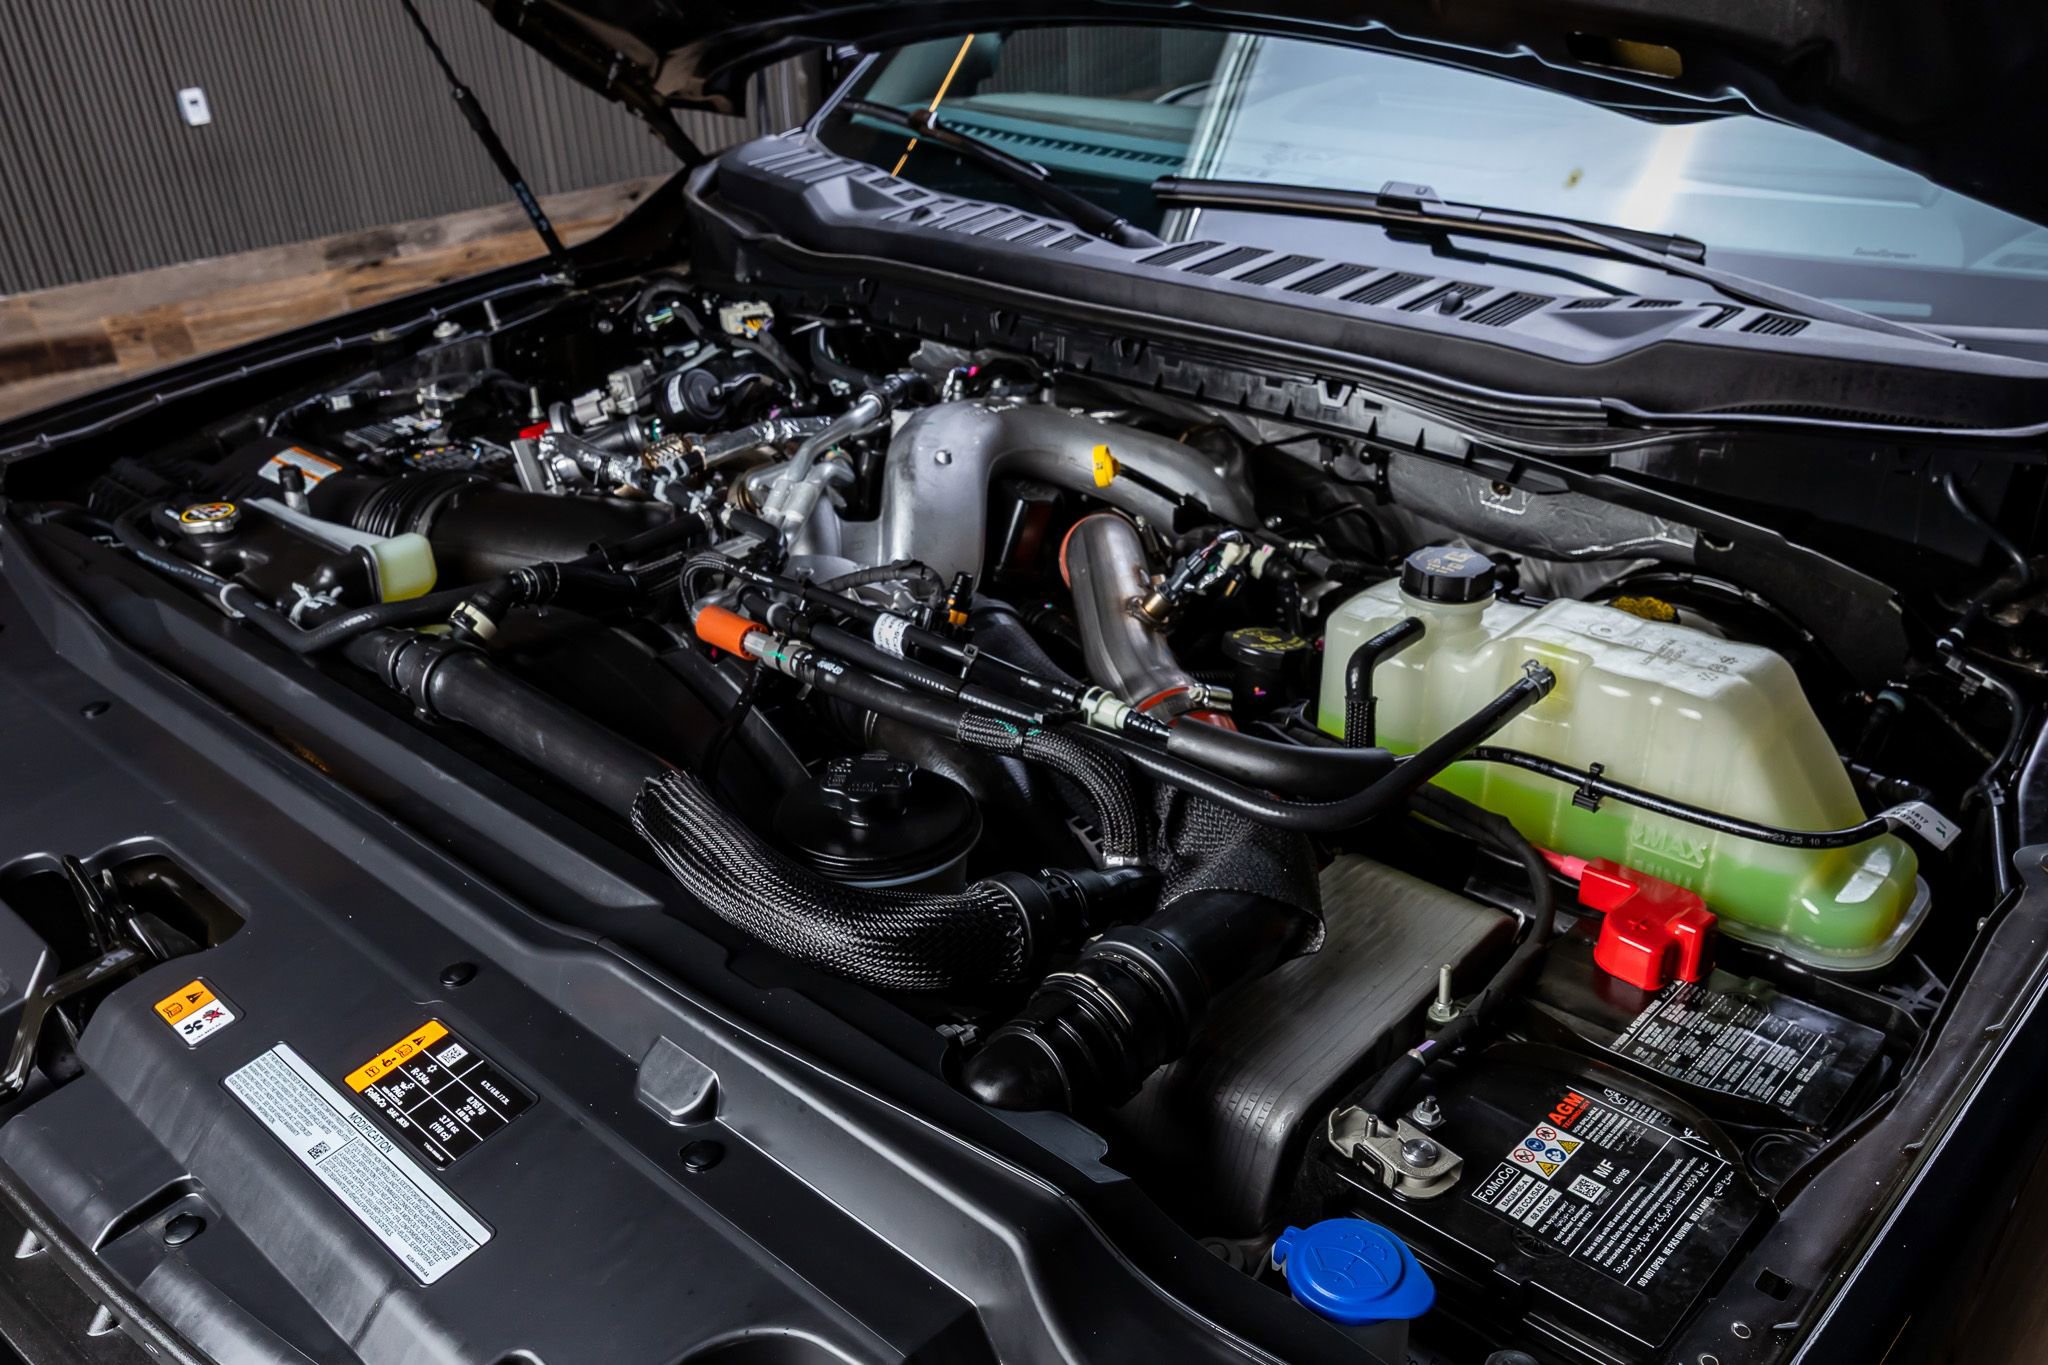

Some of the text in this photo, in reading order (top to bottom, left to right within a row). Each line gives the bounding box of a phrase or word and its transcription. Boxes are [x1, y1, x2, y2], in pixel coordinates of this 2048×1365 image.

[410, 1067, 430, 1085] R-134a
[390, 1084, 405, 1098] PAG
[364, 1087, 386, 1108] FoMoCo
[386, 1107, 399, 1119] SAE
[1549, 1092, 1583, 1124] AGM
[348, 1112, 393, 1153] MODIFICATION
[1592, 1158, 1613, 1178] MF
[1478, 1167, 1514, 1200] FoMoCo
[1501, 1179, 1529, 1207] BAGM-65-A
[1512, 1183, 1545, 1217] 750 CCA/SAE
[1529, 1194, 1555, 1220] 68 Ah C20
[1553, 1230, 1565, 1242] Ford
[1667, 1237, 1680, 1249] PAS
[1662, 1246, 1673, 1256] NE
[1636, 1277, 1648, 1287] DO
[1642, 1267, 1655, 1279] NOT
